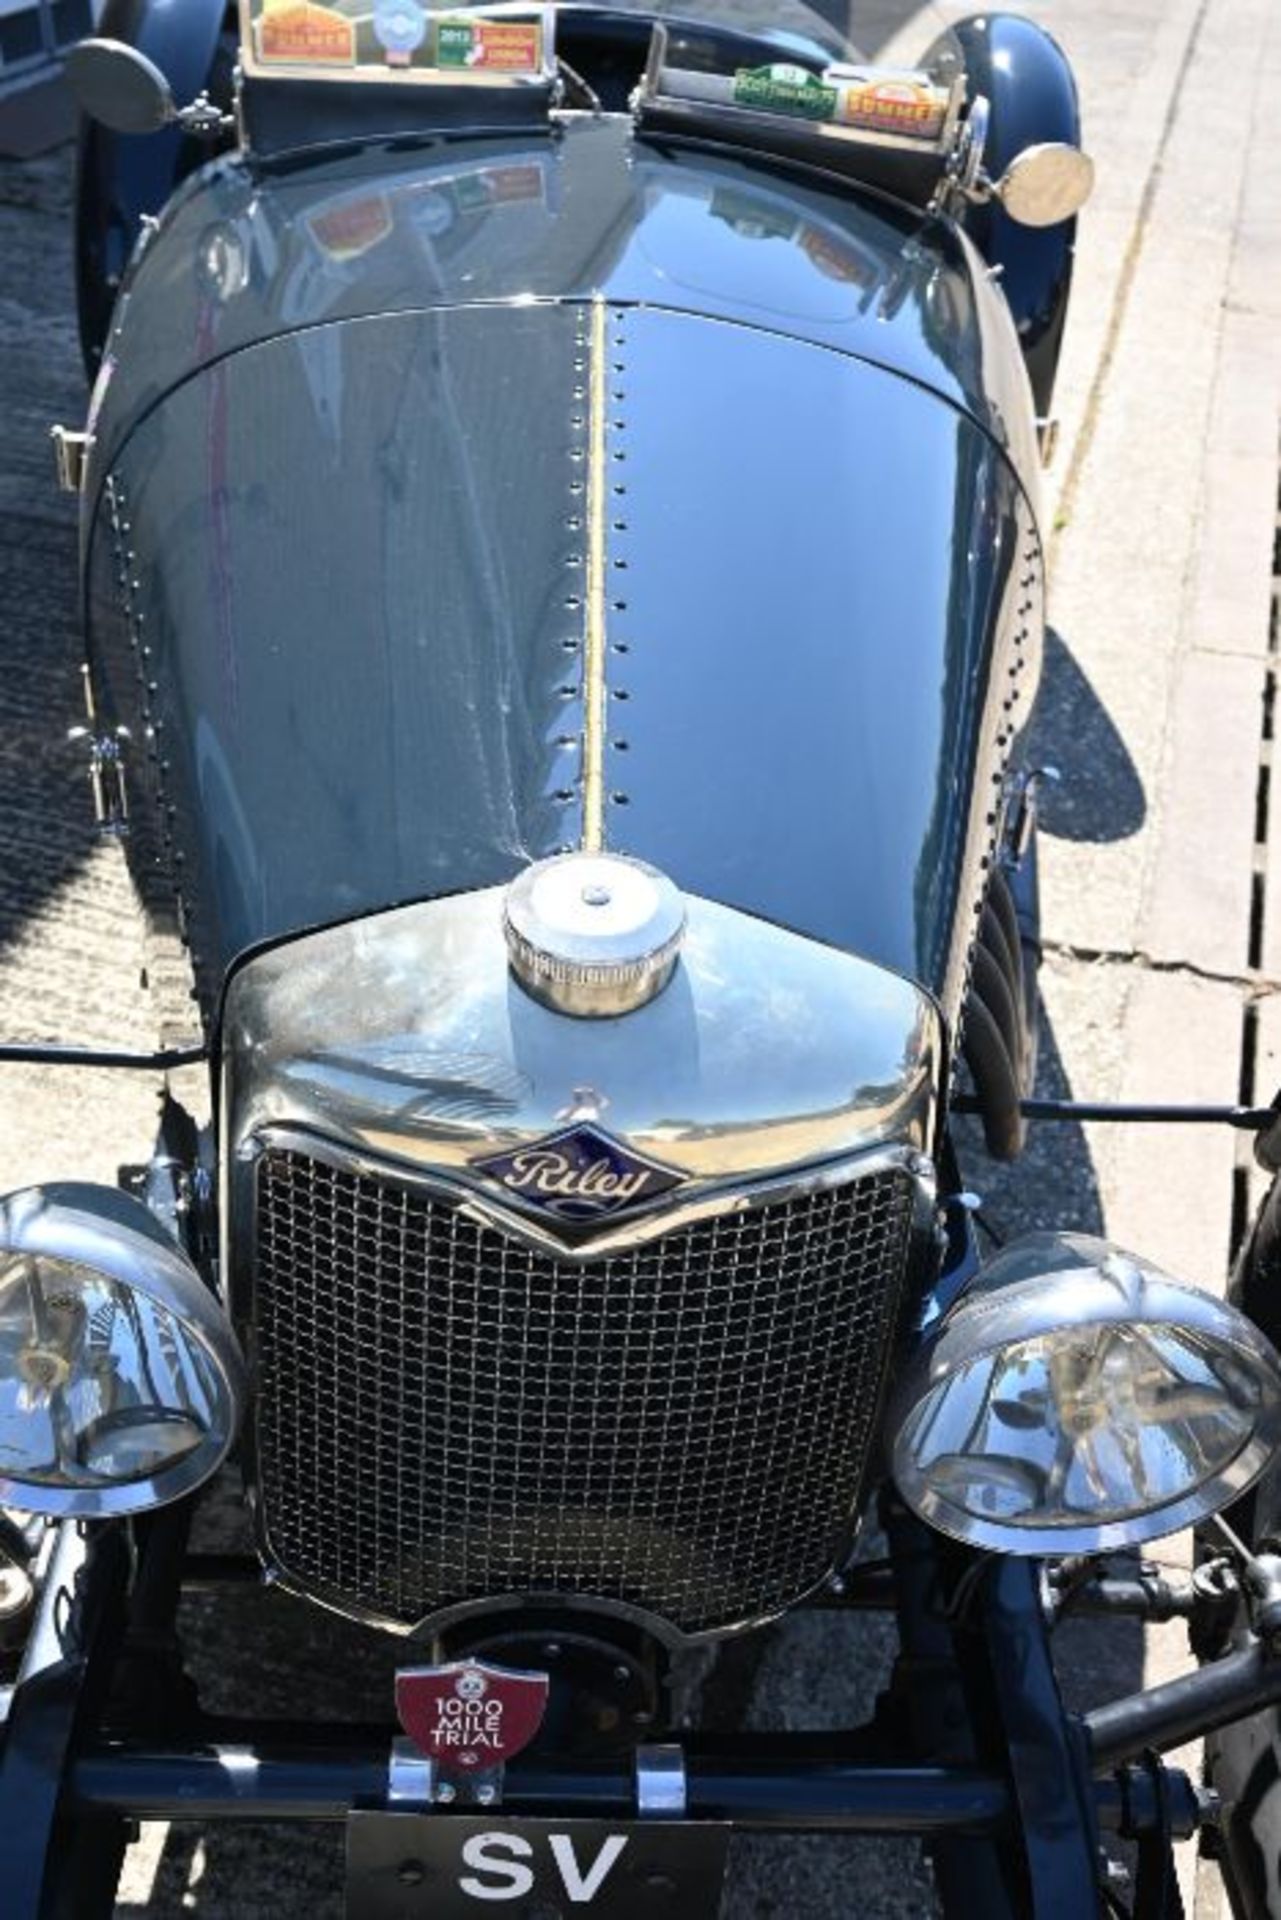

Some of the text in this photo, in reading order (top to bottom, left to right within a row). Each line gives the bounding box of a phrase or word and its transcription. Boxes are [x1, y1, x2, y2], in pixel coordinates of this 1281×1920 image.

[504, 1151, 650, 1219] Riley
[435, 1698, 503, 1715] 1000
[438, 1716, 500, 1731] MILE
[430, 1730, 504, 1748] TRIAL
[459, 1831, 629, 1903] SV
